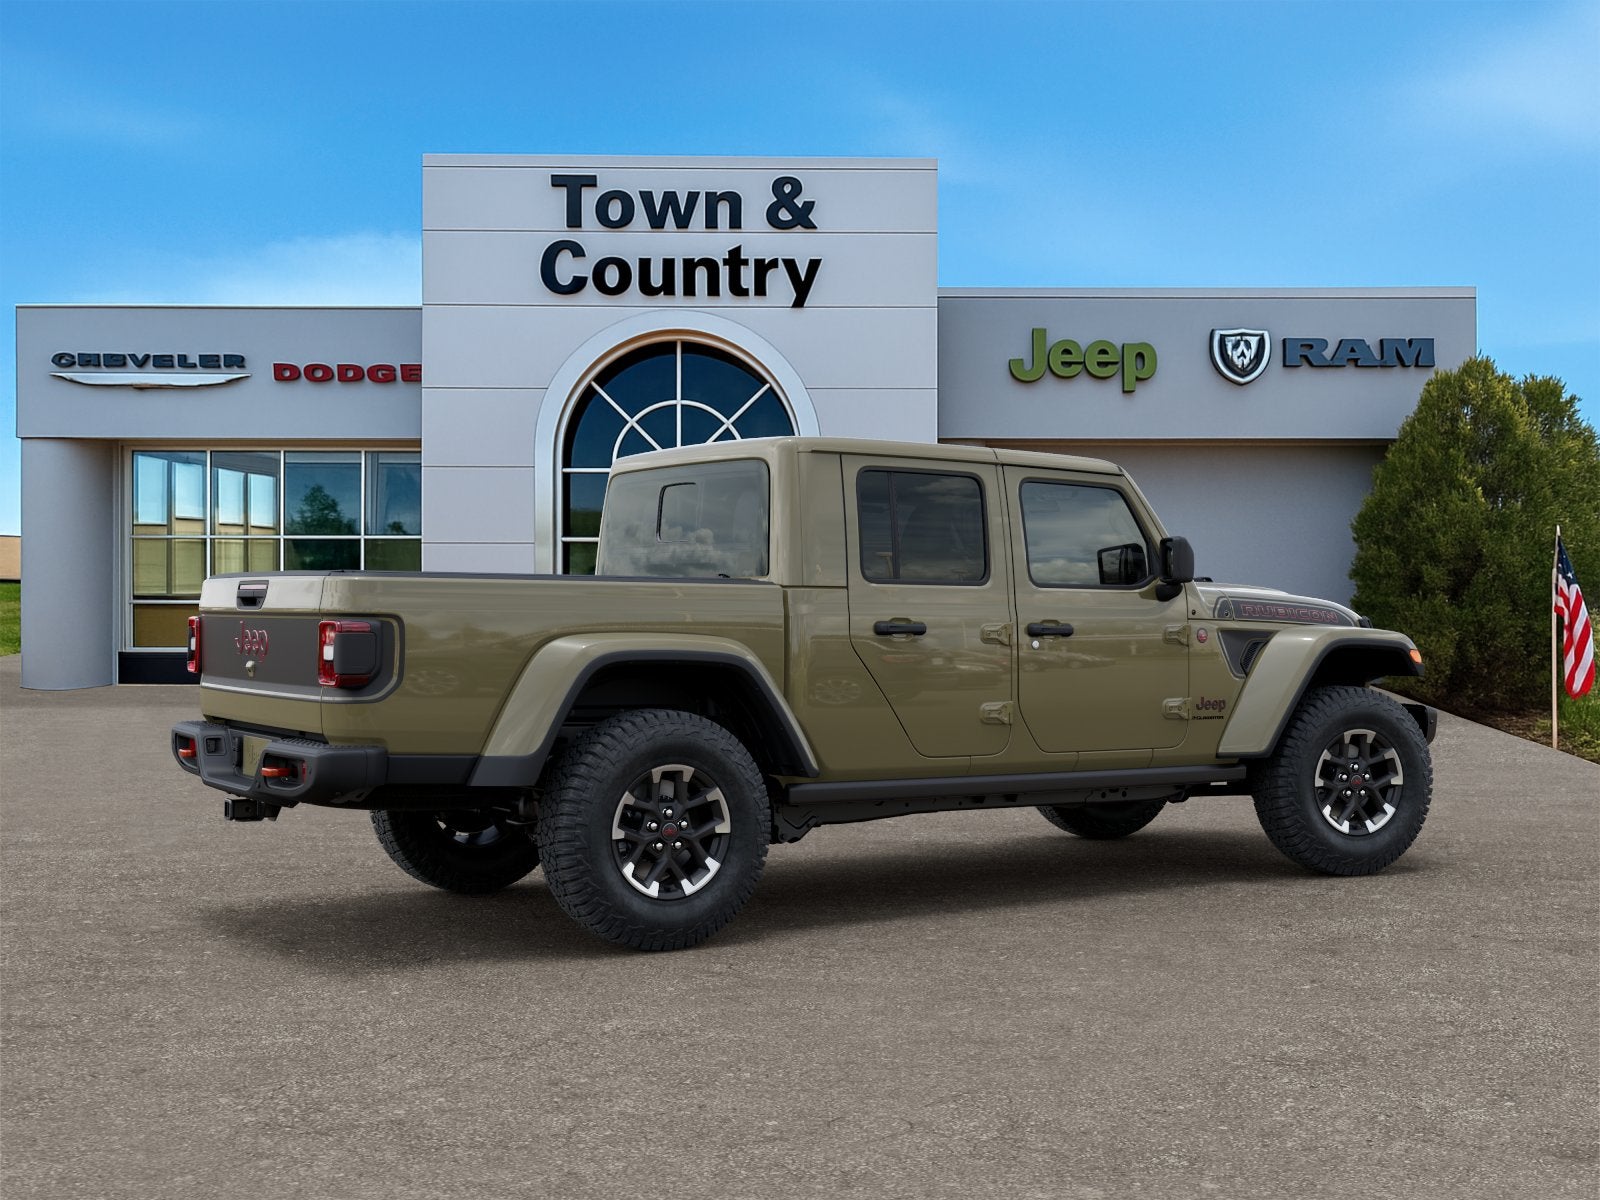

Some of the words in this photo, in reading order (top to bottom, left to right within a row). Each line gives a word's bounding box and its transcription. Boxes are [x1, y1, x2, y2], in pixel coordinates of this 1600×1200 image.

[550, 174, 742, 229] Town
[766, 176, 818, 229] &
[540, 239, 822, 308] Country
[1009, 328, 1157, 393] Jeep
[1282, 337, 1435, 368] RAM
[273, 363, 422, 383] DODGE
[1241, 604, 1338, 622] RUBICON
[1196, 696, 1226, 712] Jeep
